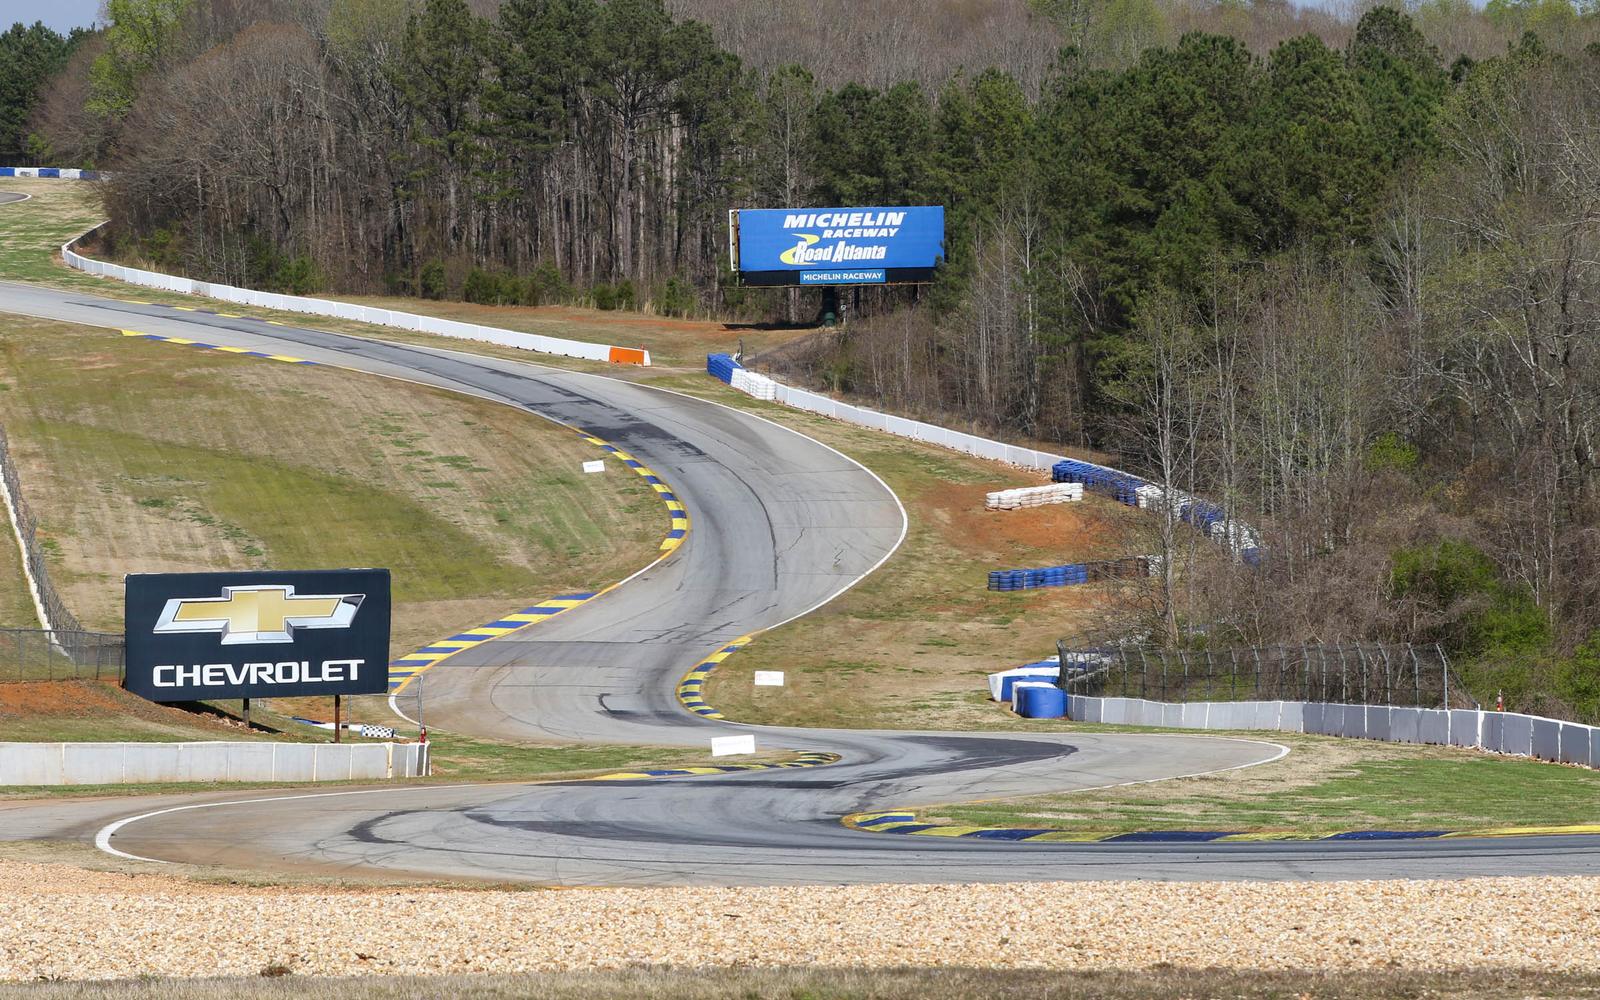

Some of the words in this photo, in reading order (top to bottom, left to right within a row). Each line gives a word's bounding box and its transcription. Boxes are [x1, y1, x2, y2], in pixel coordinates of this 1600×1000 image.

[783, 211, 905, 229] MICHELIN
[822, 228, 900, 239] RACEWAY
[794, 240, 834, 263] Road
[831, 240, 887, 263] Atlanta
[803, 273, 841, 281] MICHELIN
[843, 272, 882, 280] RACEWAY
[152, 659, 365, 687] CHEVROLET
